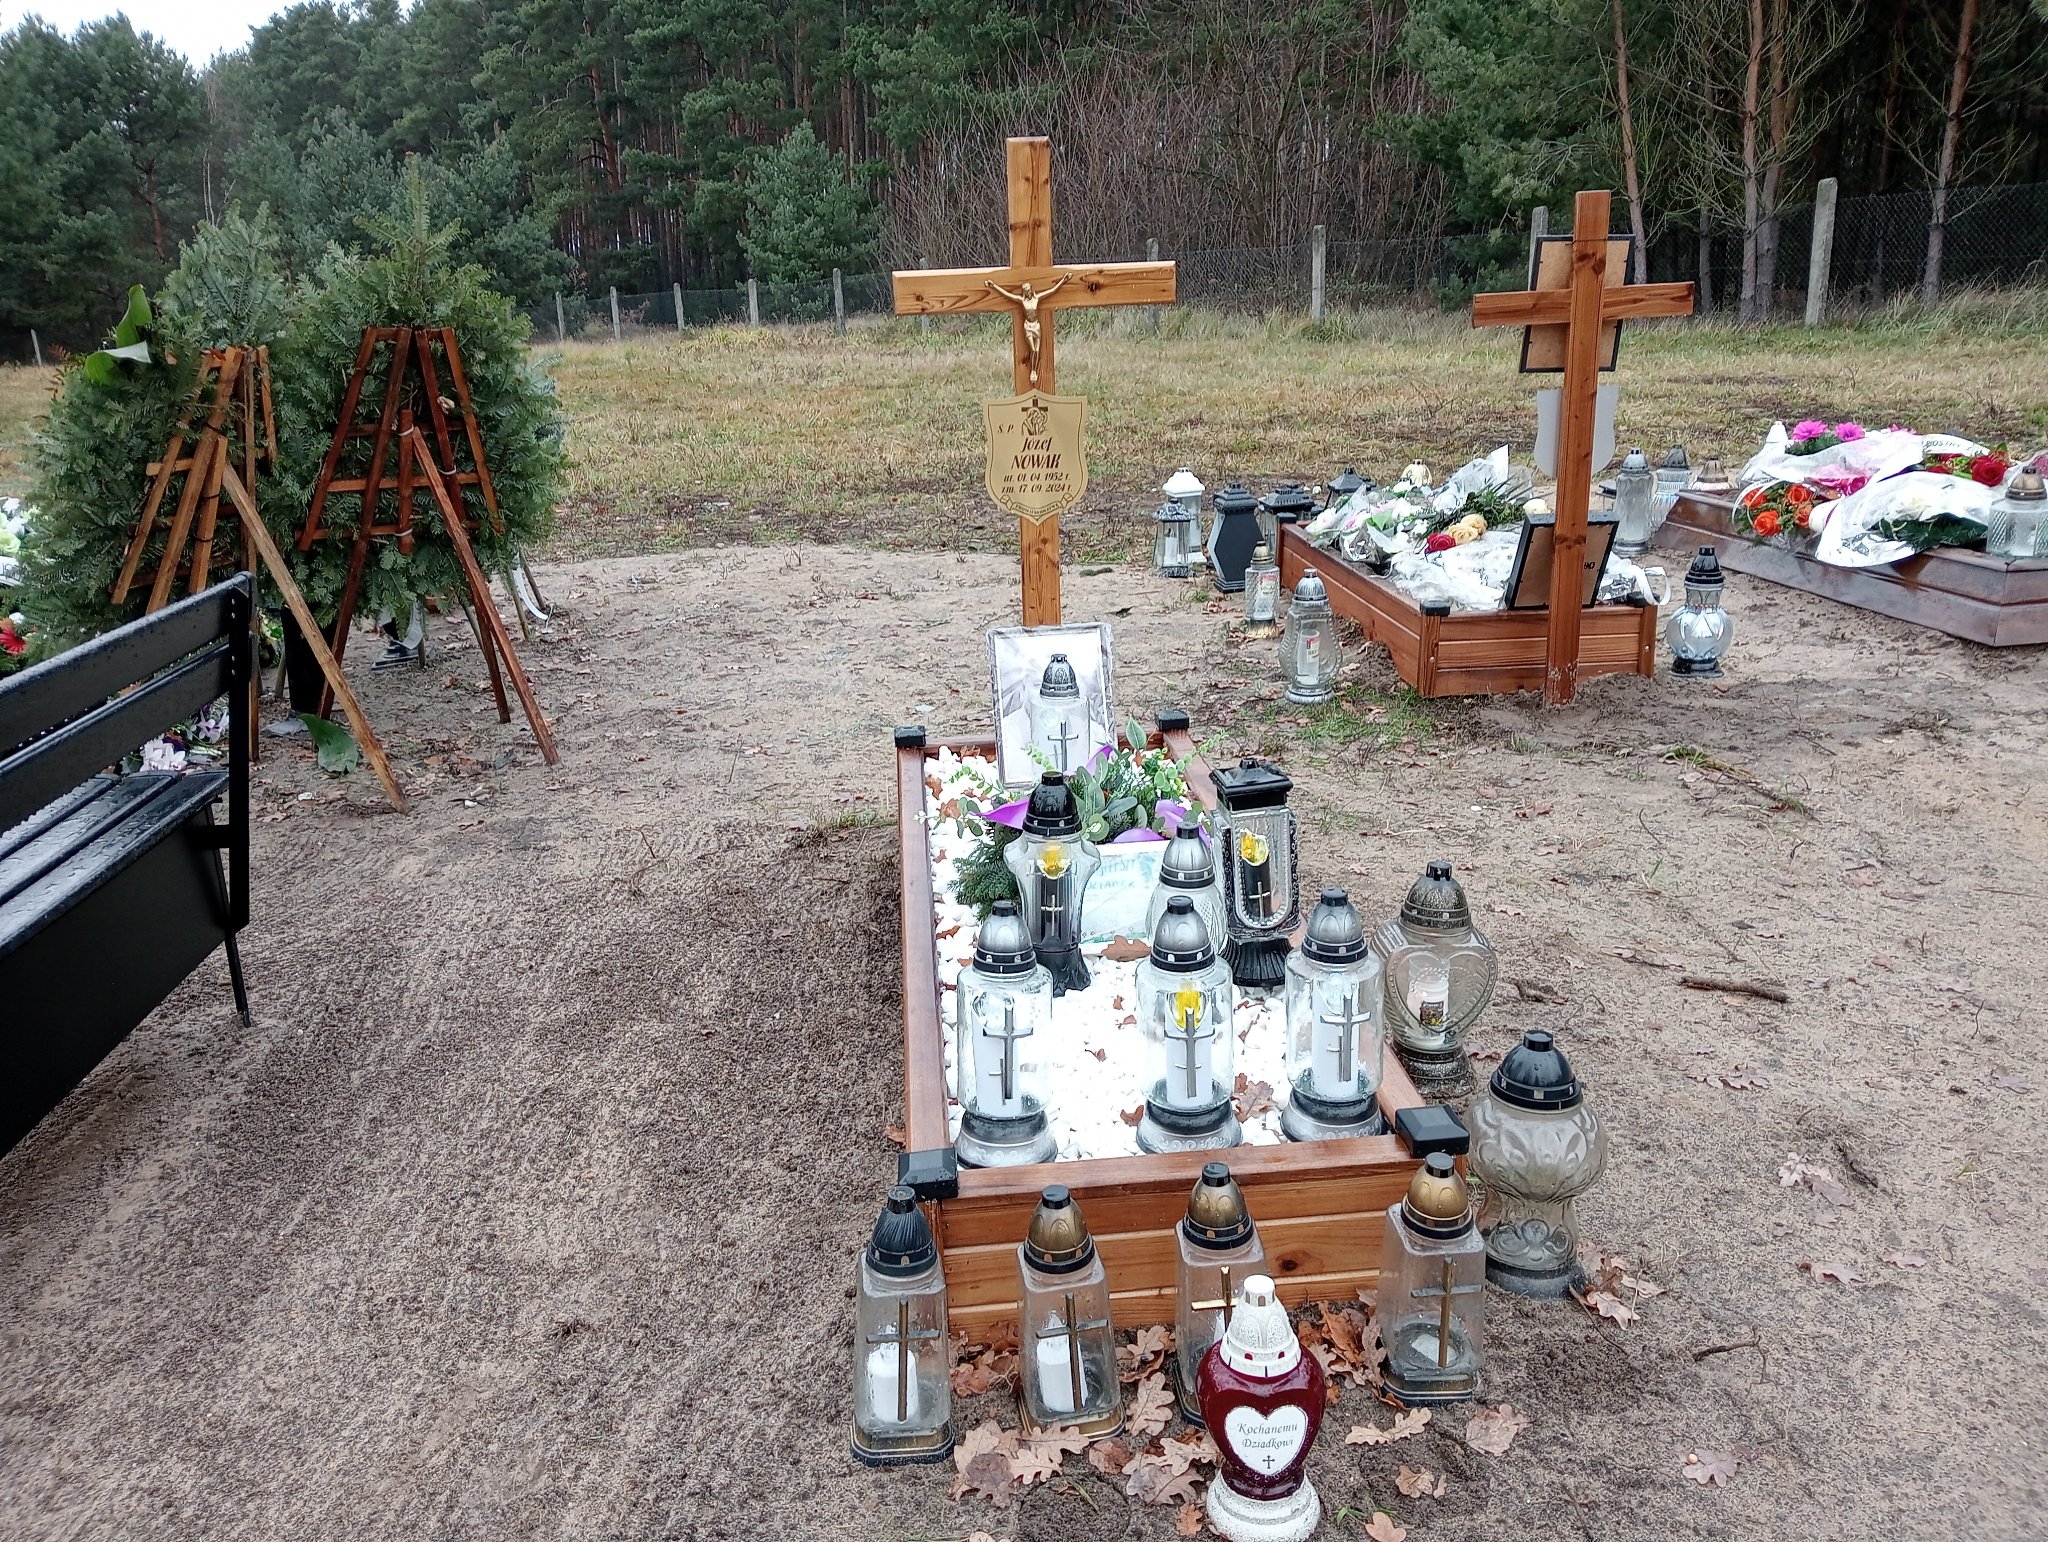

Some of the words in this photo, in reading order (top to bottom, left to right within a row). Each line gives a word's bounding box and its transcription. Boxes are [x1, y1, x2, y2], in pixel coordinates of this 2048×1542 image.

[1011, 454, 1061, 469] NOWAK
[1237, 1423, 1298, 1436] Kochanemu
[1242, 1437, 1294, 1450] Dziadkowi
